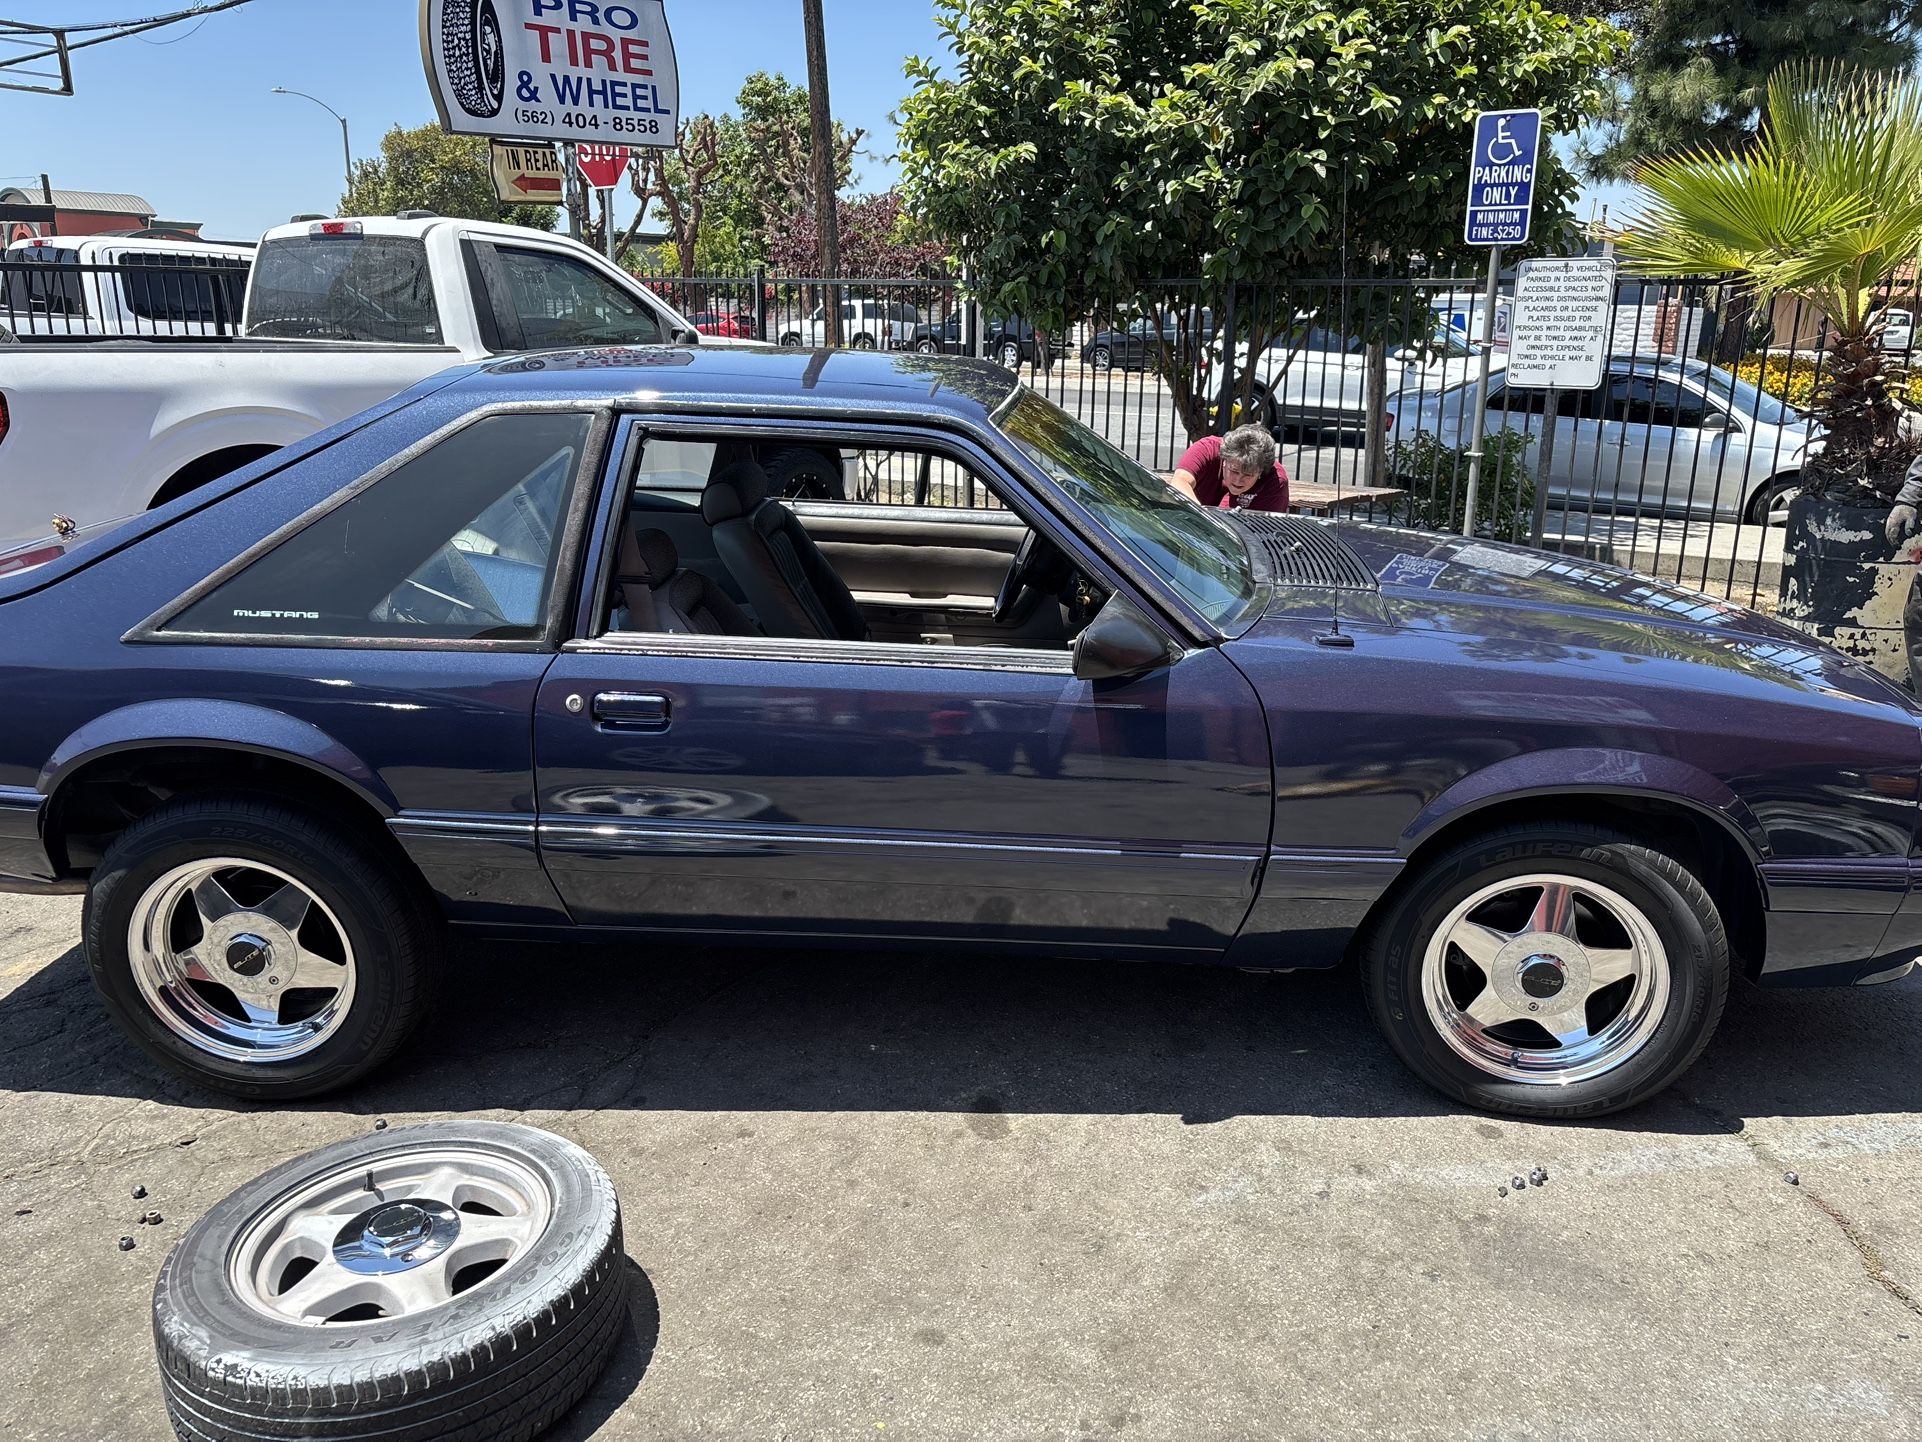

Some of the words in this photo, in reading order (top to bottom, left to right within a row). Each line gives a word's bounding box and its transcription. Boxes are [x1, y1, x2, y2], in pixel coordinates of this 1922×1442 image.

[532, 0, 639, 31] PRO
[524, 22, 653, 76] TIRE
[515, 70, 542, 104] &
[550, 73, 671, 115] WHEEL
[514, 107, 555, 126] (562)
[561, 112, 660, 135] 404-8558
[506, 149, 521, 170] IN
[524, 149, 559, 171] REAR
[1474, 164, 1531, 184] PARKING
[1483, 186, 1518, 205] ONLY
[1476, 210, 1520, 224] MINIMUM
[1472, 226, 1493, 239] FINE
[1497, 225, 1521, 239] $250
[233, 609, 319, 619] MUSTANG
